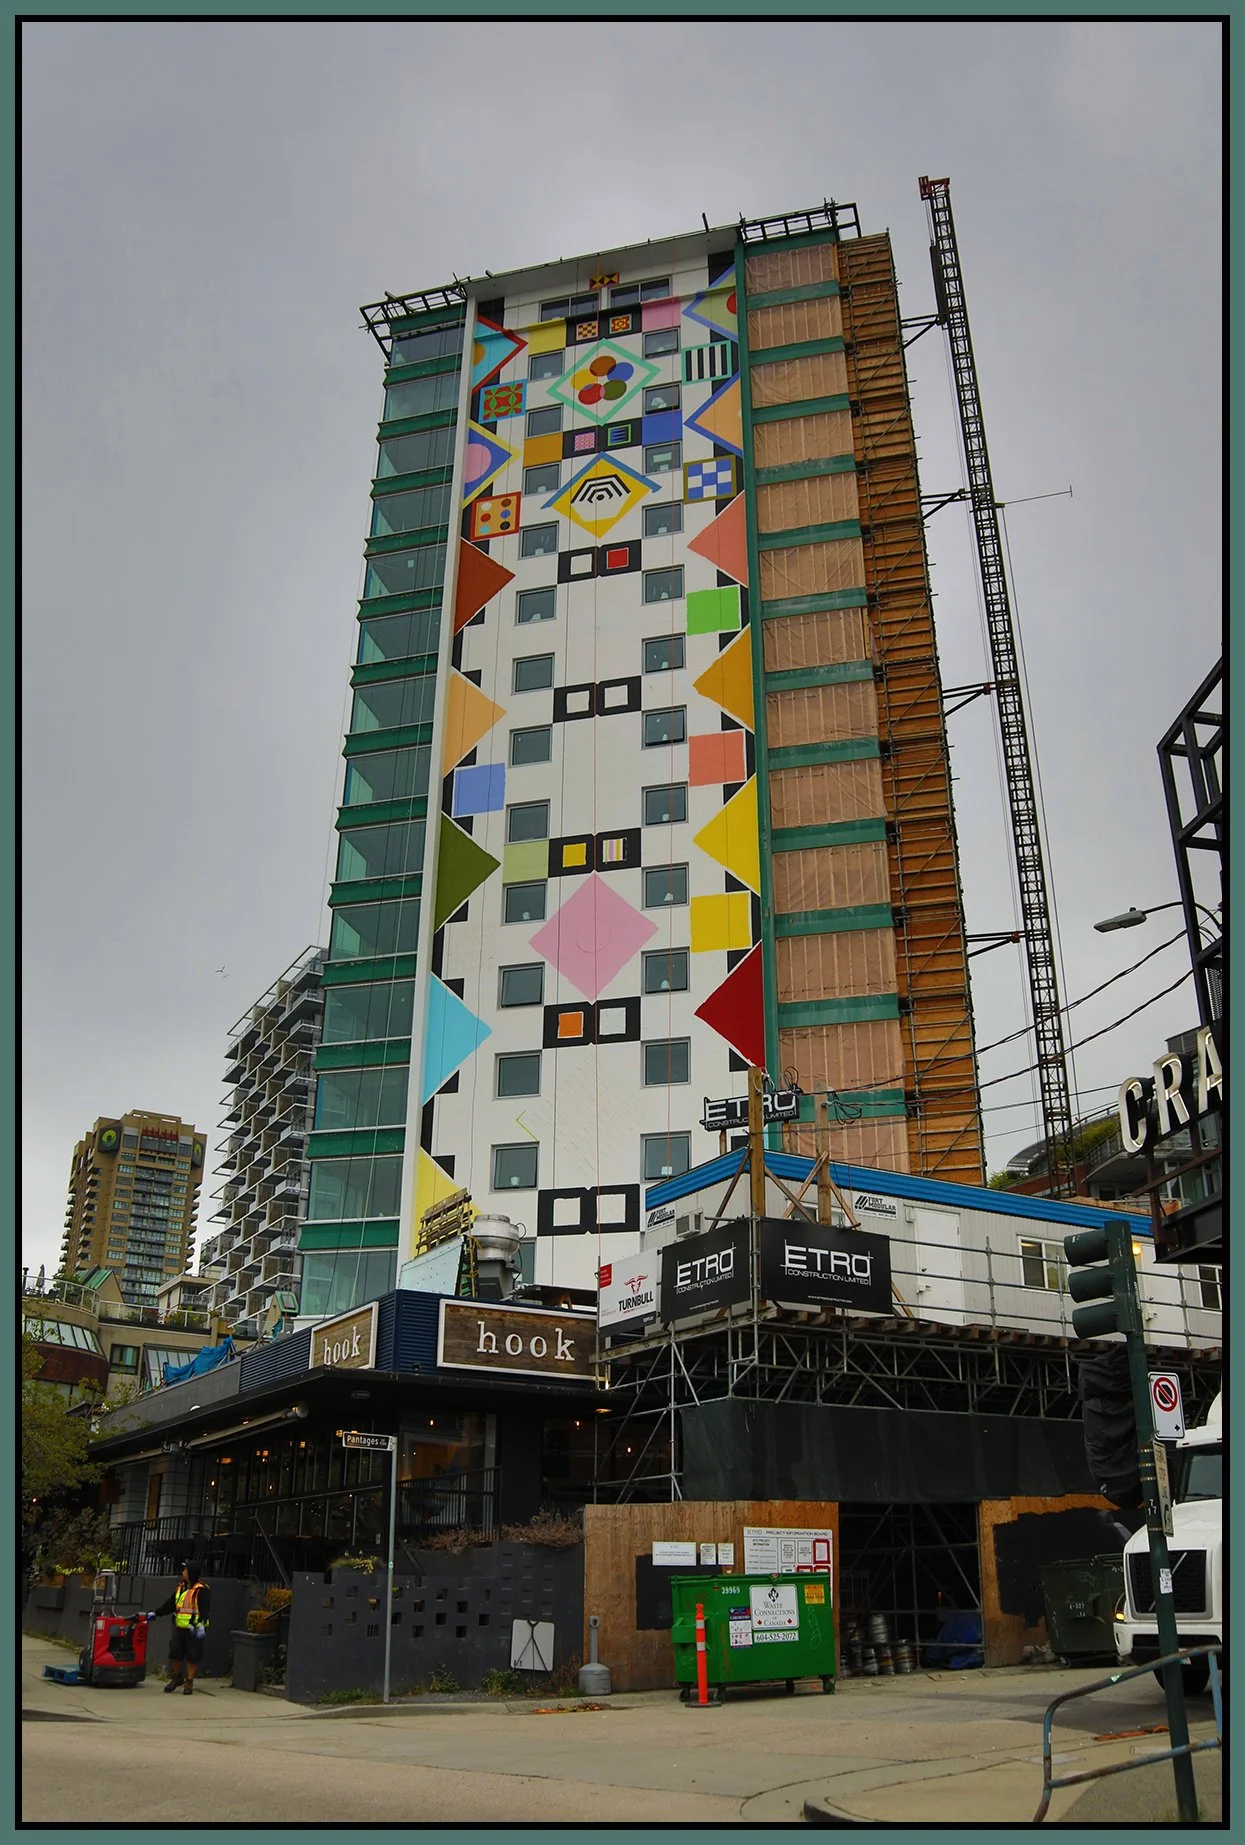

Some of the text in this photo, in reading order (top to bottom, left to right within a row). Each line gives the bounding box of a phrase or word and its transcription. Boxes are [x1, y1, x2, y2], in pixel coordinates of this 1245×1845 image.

[765, 1110, 795, 1120] LIMITED
[677, 1248, 734, 1288] ETRO
[785, 1244, 871, 1278] ETRO
[678, 1272, 732, 1294] CONSTRUCTION LIMITED
[787, 1268, 869, 1286] CONSTRUCTION LIMITED
[618, 1291, 654, 1312] TURNBULL
[323, 1325, 361, 1366] hook
[476, 1320, 575, 1361] hook
[347, 1434, 379, 1447] Pantages
[754, 1608, 796, 1616] CONNECTIONS
[763, 1601, 783, 1609] WASTE
[763, 1619, 786, 1627] CANADA
[756, 1632, 797, 1641] 604-525-2072
